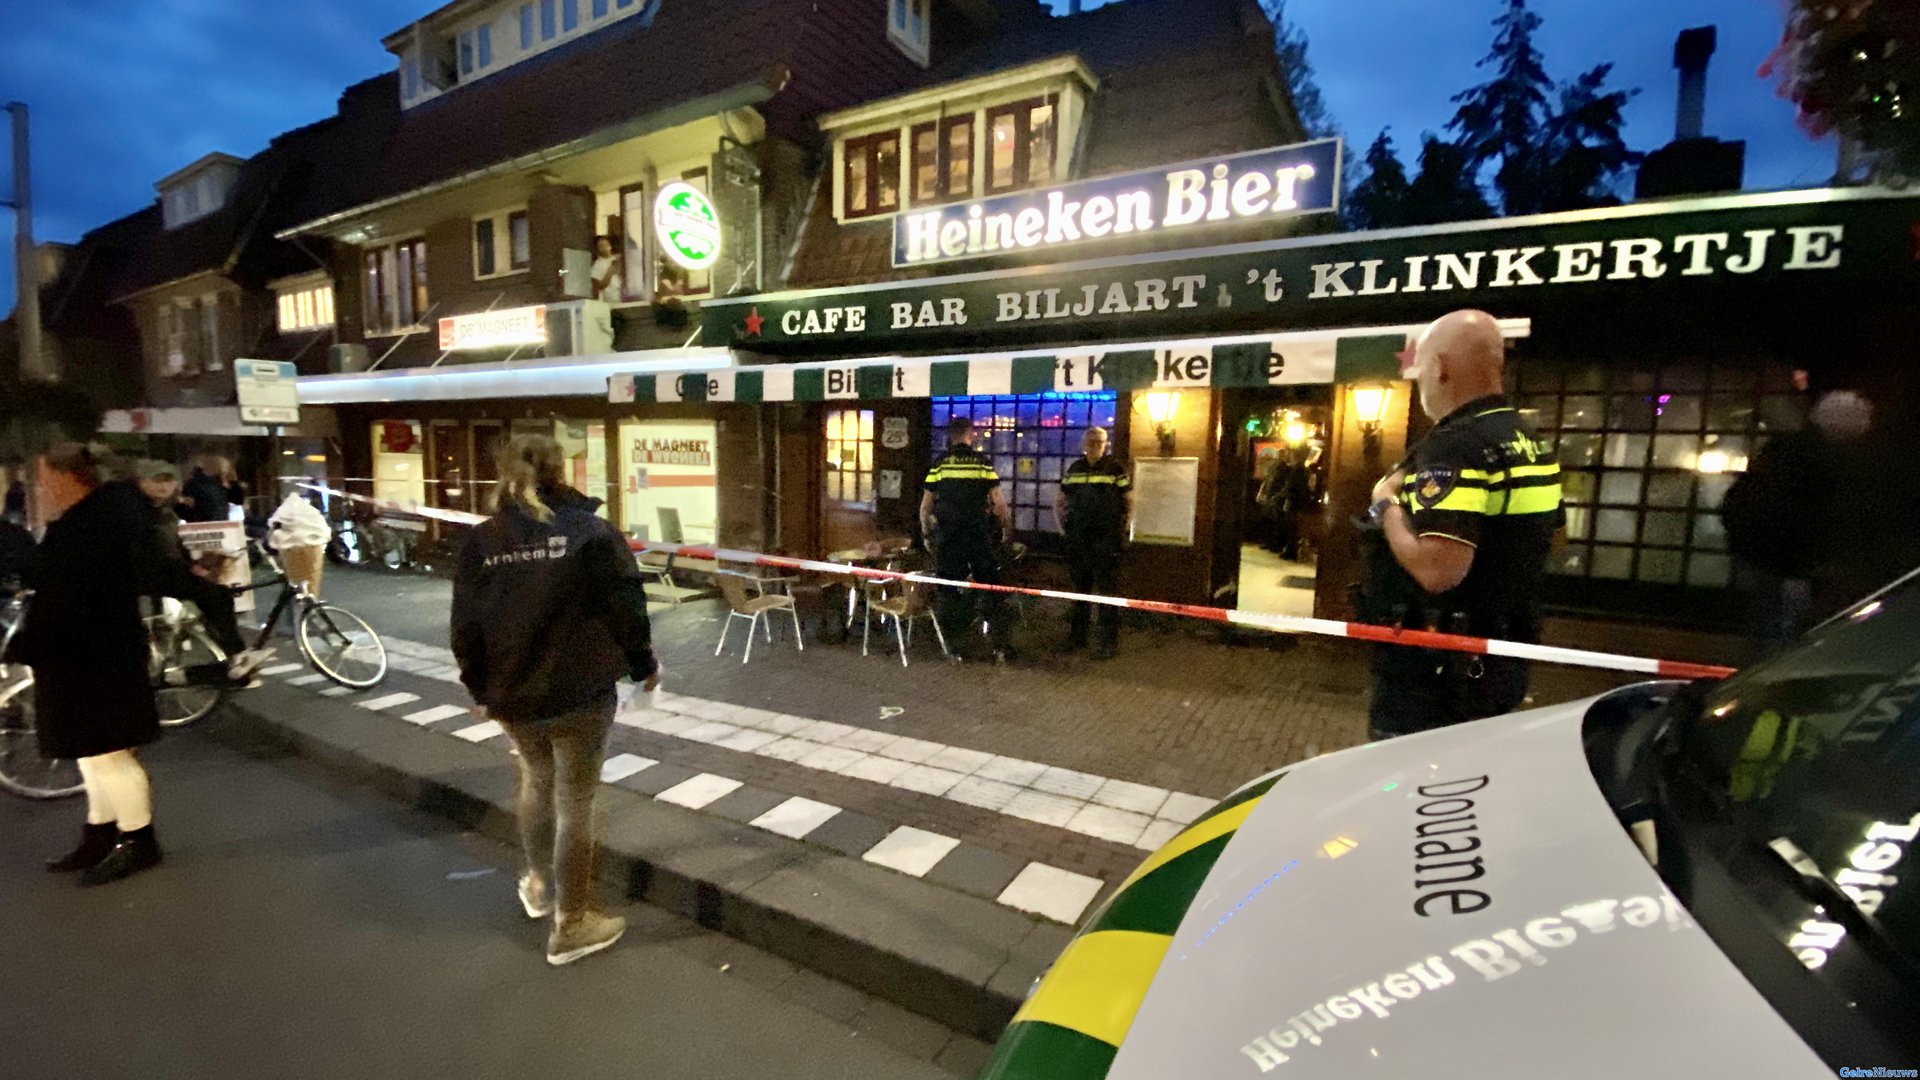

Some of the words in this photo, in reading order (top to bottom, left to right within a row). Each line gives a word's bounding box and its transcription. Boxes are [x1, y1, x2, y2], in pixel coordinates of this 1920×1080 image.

[905, 186, 1154, 263] Heineken
[1162, 162, 1317, 227] Bier
[782, 305, 866, 335] CAFE
[891, 297, 968, 330] BAR
[996, 274, 1207, 322] BILJART
[1308, 224, 1845, 300] KLINKERTJE
[1413, 773, 1492, 918] Douane
